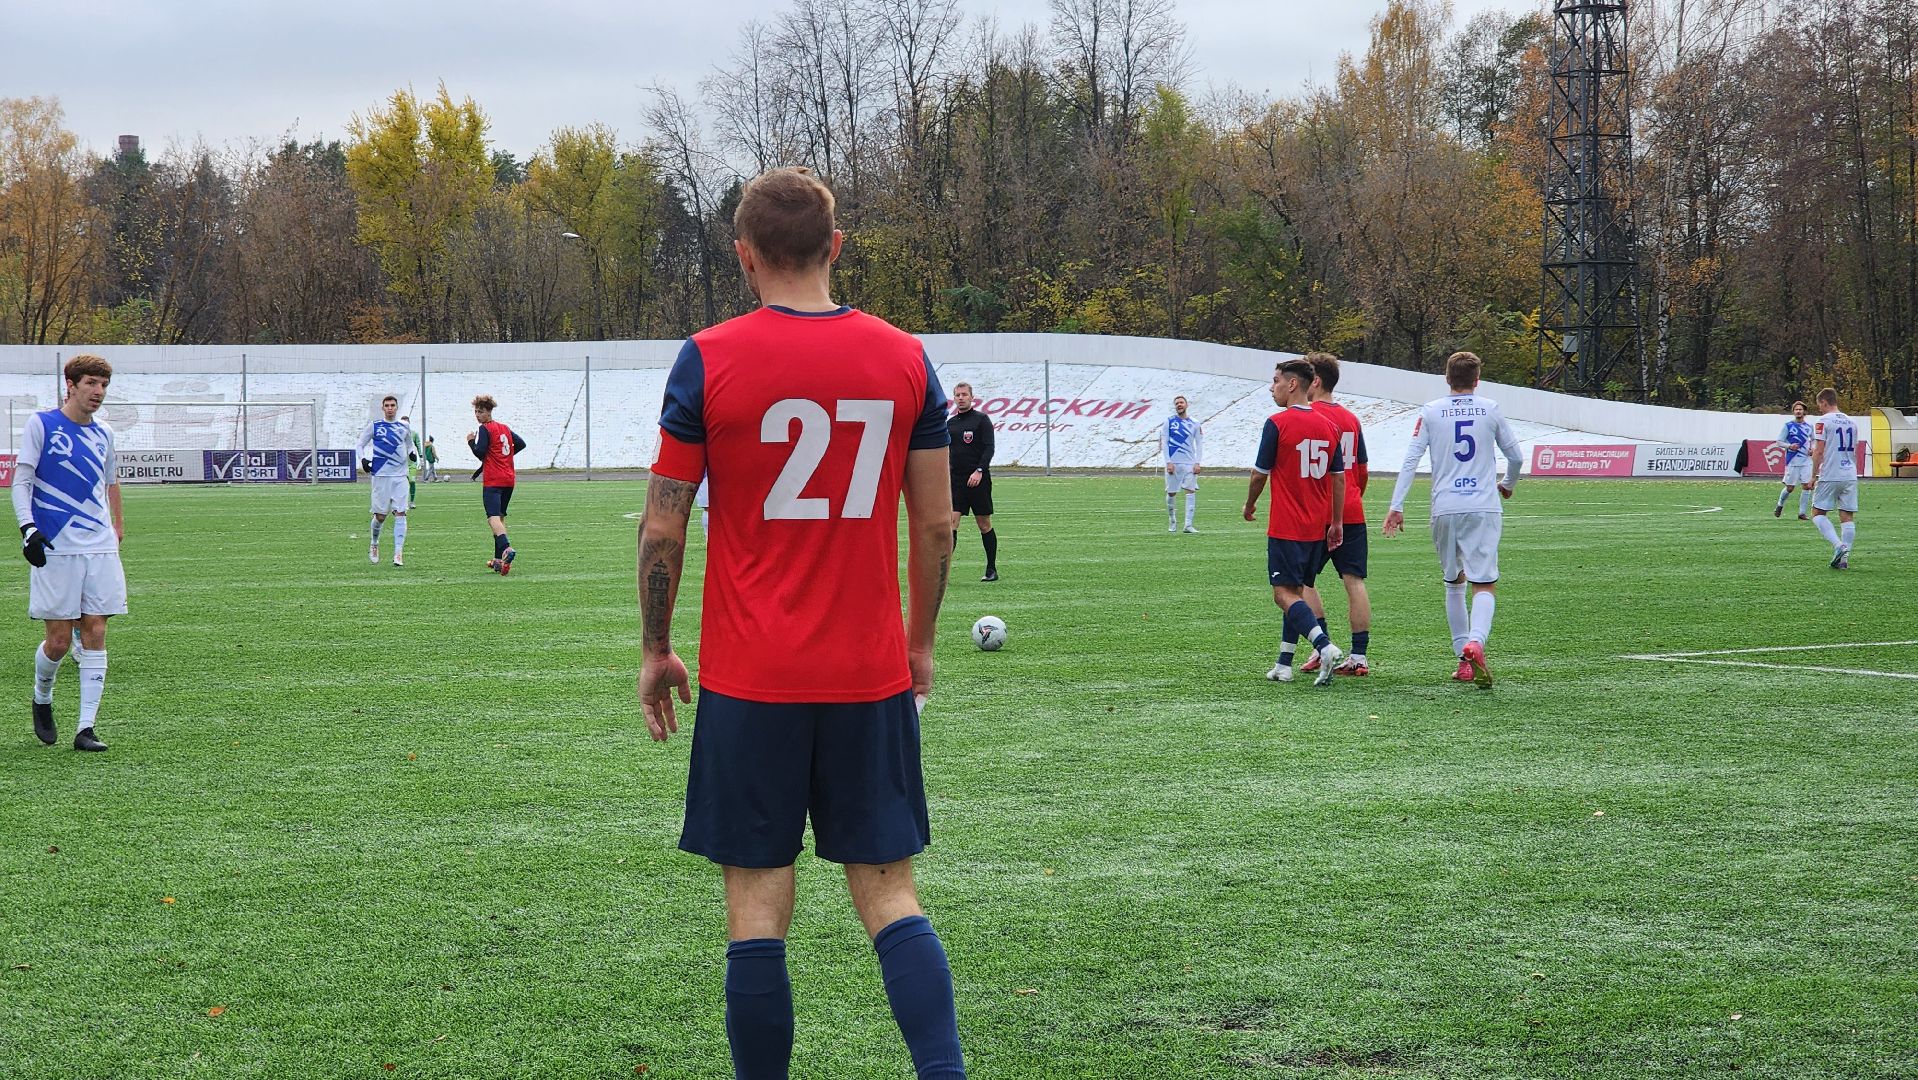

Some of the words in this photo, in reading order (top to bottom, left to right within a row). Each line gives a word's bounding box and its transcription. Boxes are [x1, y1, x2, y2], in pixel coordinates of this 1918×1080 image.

[947, 397, 1154, 420] РОДСКИЙ
[1441, 408, 1487, 418] ЛЕБЕДЕВ
[1454, 420, 1476, 462] 5
[1836, 427, 1855, 451] 11
[122, 454, 137, 462] НА
[141, 453, 174, 462] САЙТЕ
[1701, 446, 1725, 455] САЙТЕ
[760, 398, 895, 520] 27
[1296, 438, 1330, 480] 15
[1567, 460, 1598, 470] Znamya
[1600, 460, 1611, 468] TV
[1454, 478, 1477, 488] GPS
